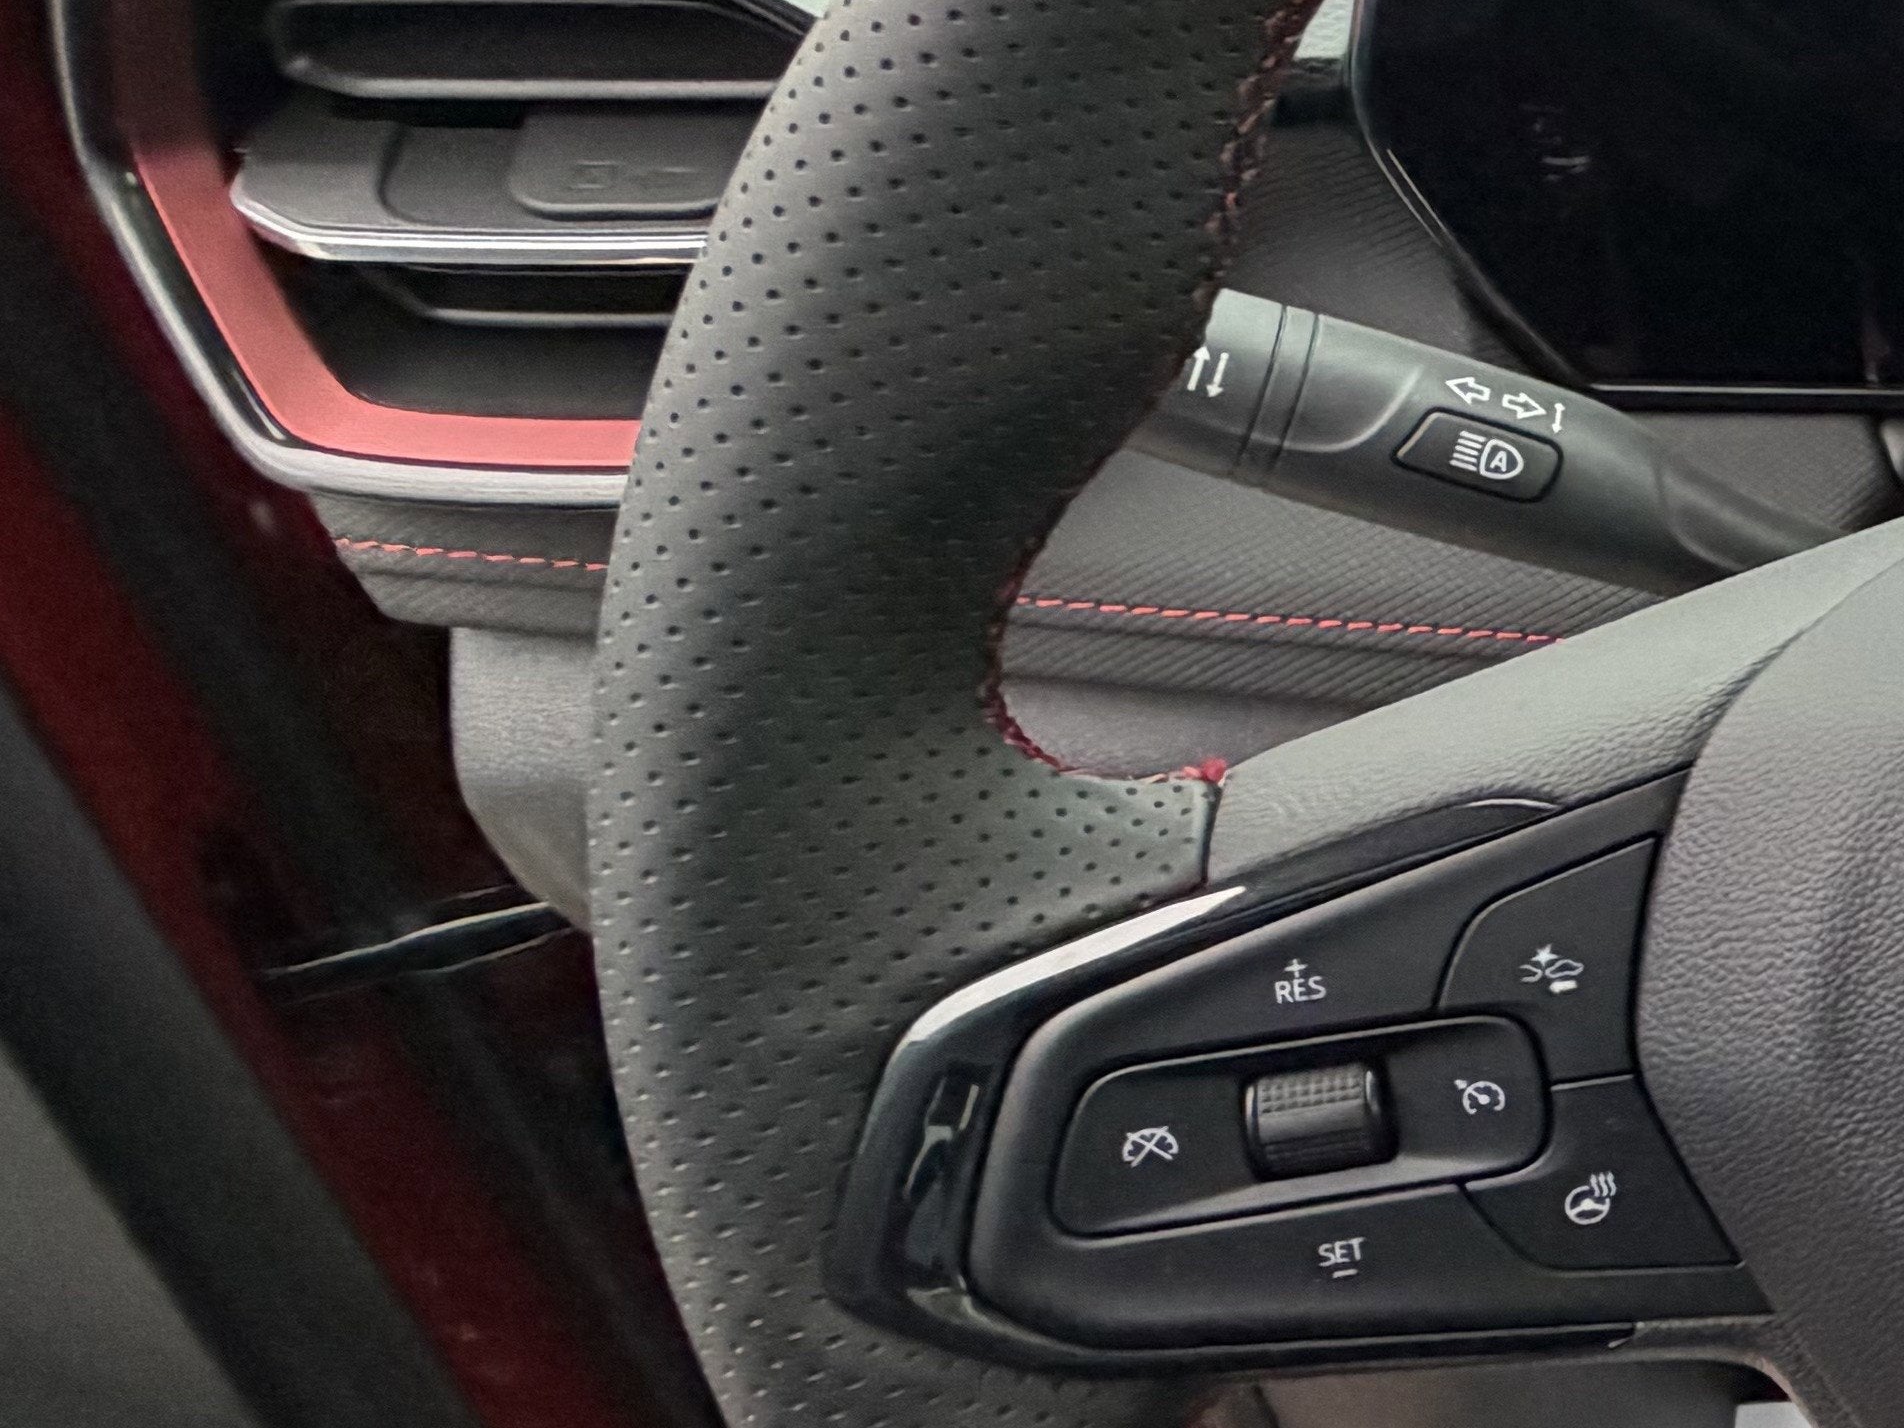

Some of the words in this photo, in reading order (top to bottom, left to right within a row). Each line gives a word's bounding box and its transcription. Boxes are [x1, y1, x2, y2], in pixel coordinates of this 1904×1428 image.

[1490, 451, 1507, 472] A
[1274, 975, 1327, 1004] RES
[1318, 1236, 1367, 1267] SET
